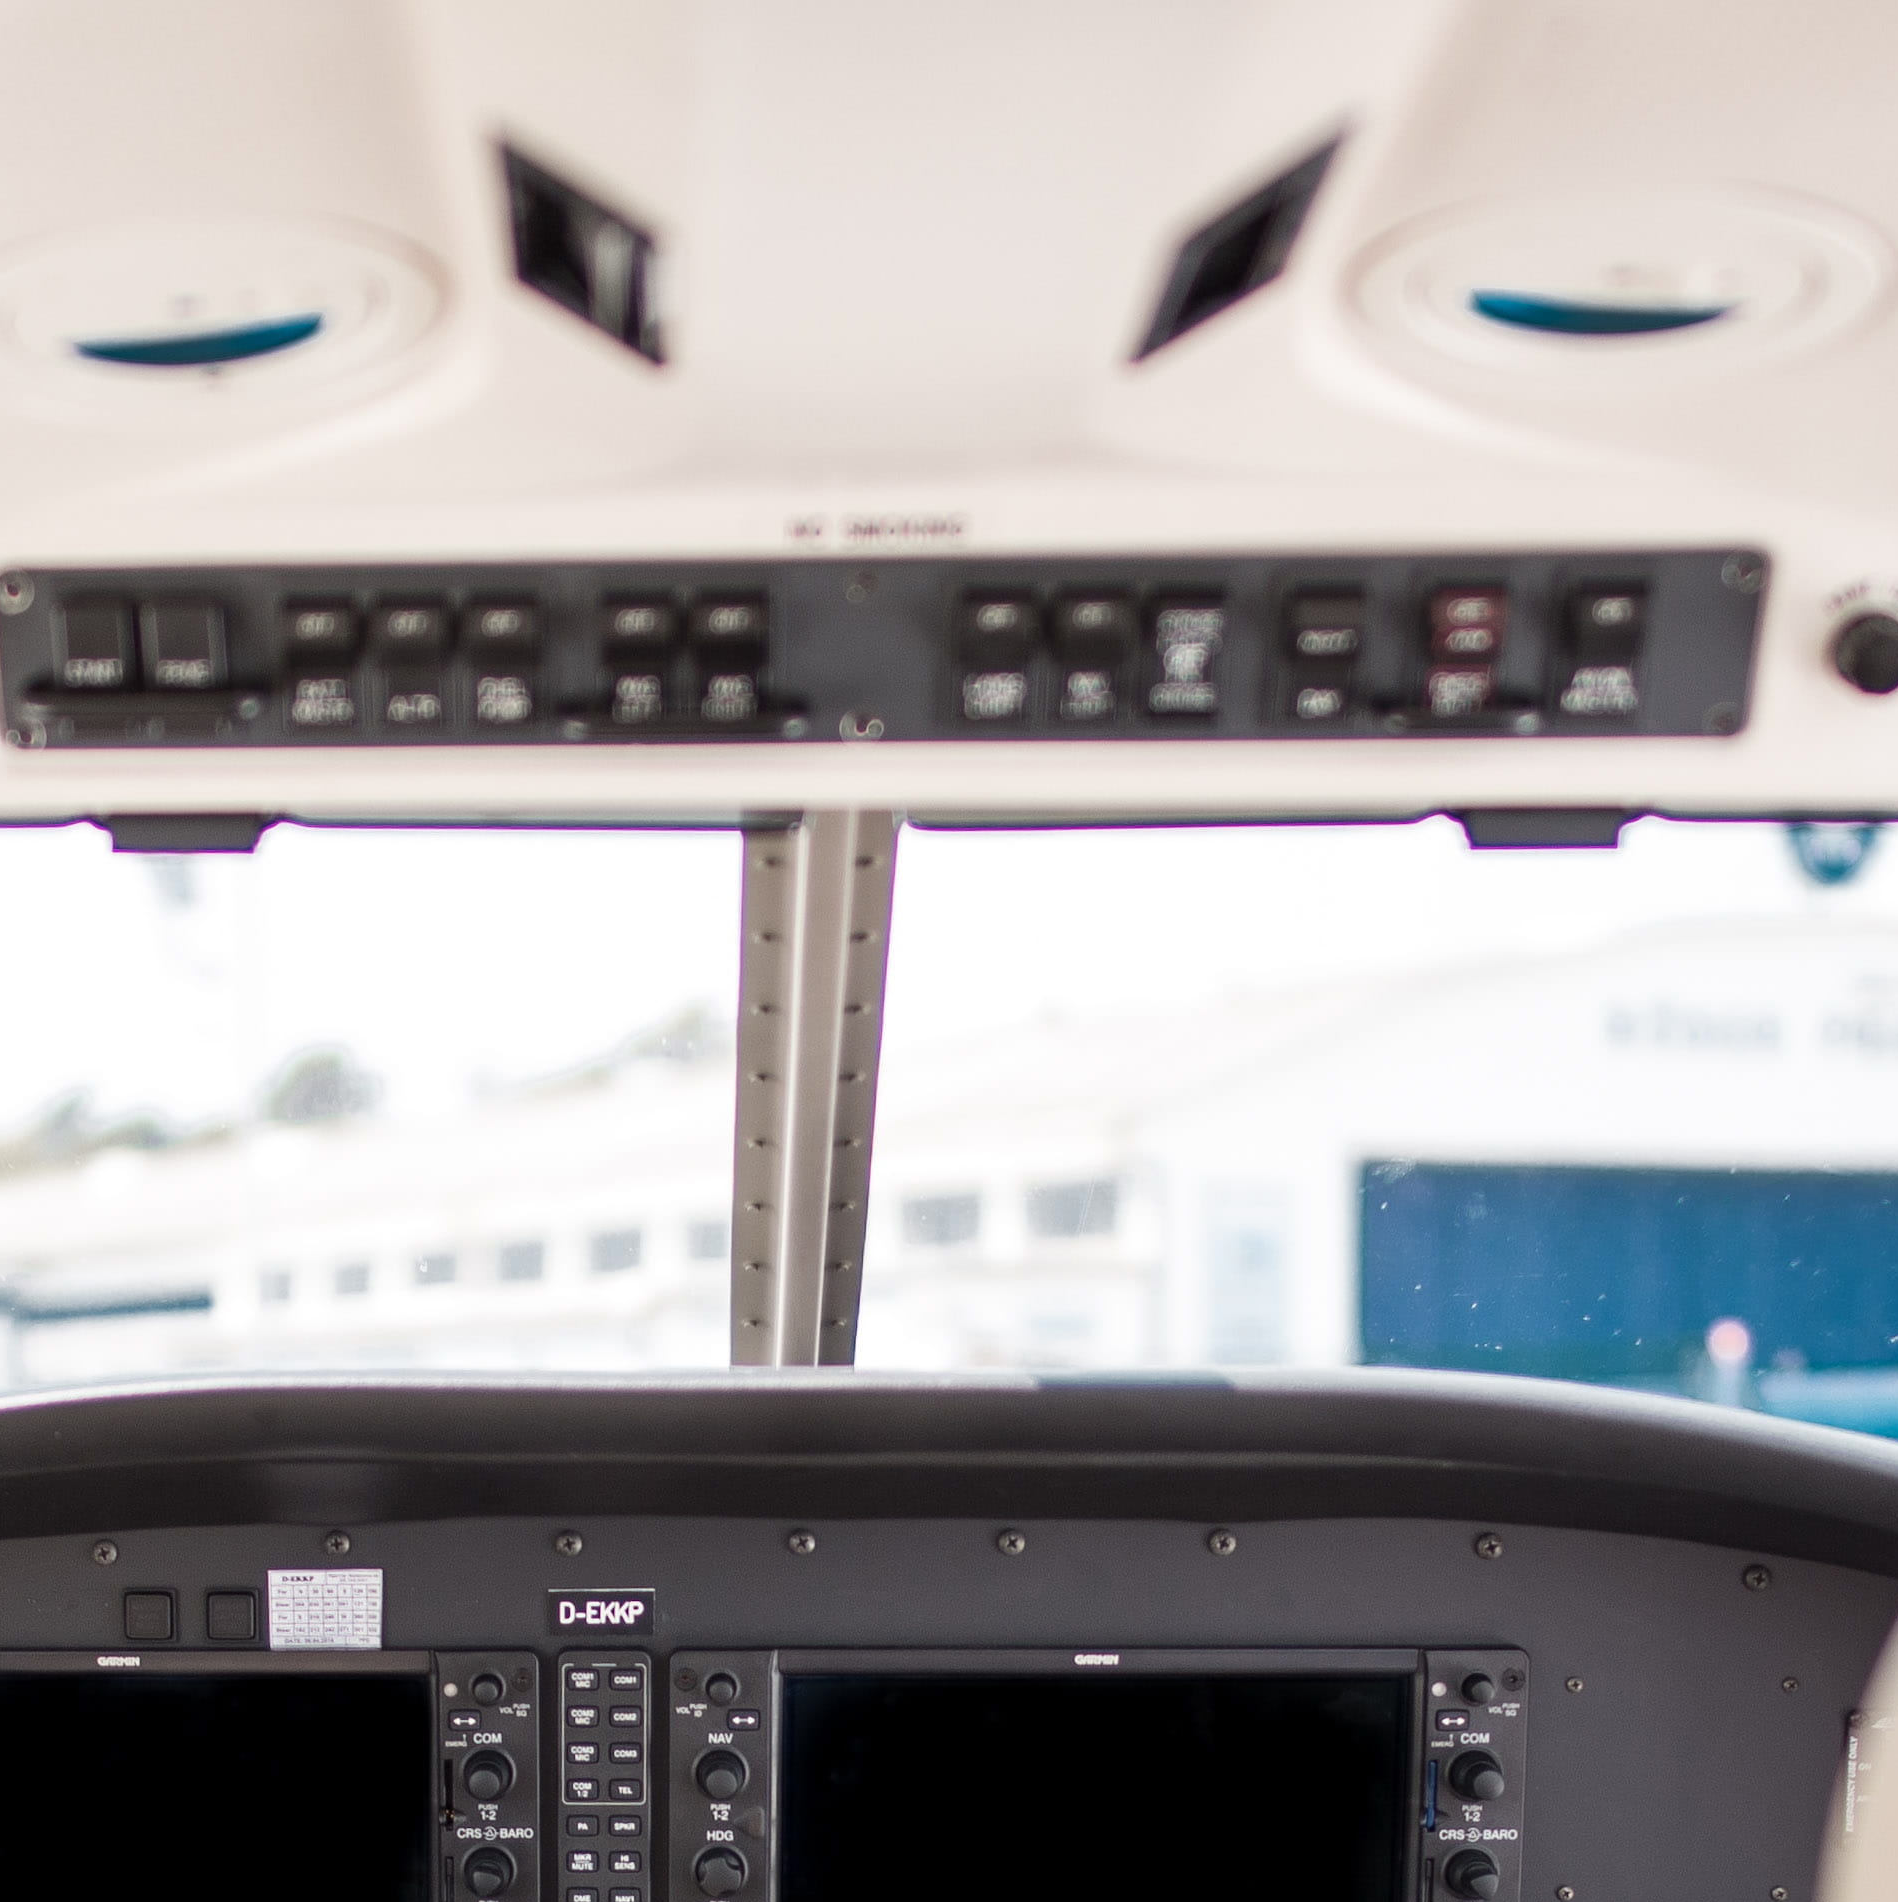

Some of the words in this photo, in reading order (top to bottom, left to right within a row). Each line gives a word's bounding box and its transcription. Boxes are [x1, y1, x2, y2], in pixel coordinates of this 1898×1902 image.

[558, 1601, 645, 1625] D-EKKP
[97, 1656, 140, 1667] GARMIN
[1074, 1654, 1119, 1665] GARMIN
[571, 1672, 594, 1681] COM1
[614, 1676, 637, 1685] COM1
[575, 1680, 591, 1689] MIC
[499, 1707, 513, 1715] VOL
[571, 1709, 594, 1717] COM2
[675, 1706, 690, 1714] VOL
[1488, 1706, 1503, 1714] VOL
[613, 1713, 636, 1721] COM2
[473, 1732, 502, 1744] COM
[708, 1733, 733, 1744] NAV
[1460, 1732, 1490, 1744] COM
[613, 1749, 637, 1758] COM3
[618, 1786, 633, 1795] TEL
[478, 1803, 498, 1811] PUSH
[481, 1811, 496, 1821] 1-2
[713, 1810, 729, 1820] 1-2
[1464, 1811, 1481, 1822] 1-2
[577, 1822, 589, 1831] PA
[456, 1828, 482, 1839] CRS
[499, 1828, 534, 1839] BARO
[706, 1830, 734, 1842] HDG
[1439, 1829, 1465, 1840] CRS
[1482, 1829, 1518, 1840] BARO
[573, 1894, 591, 1902] DME
